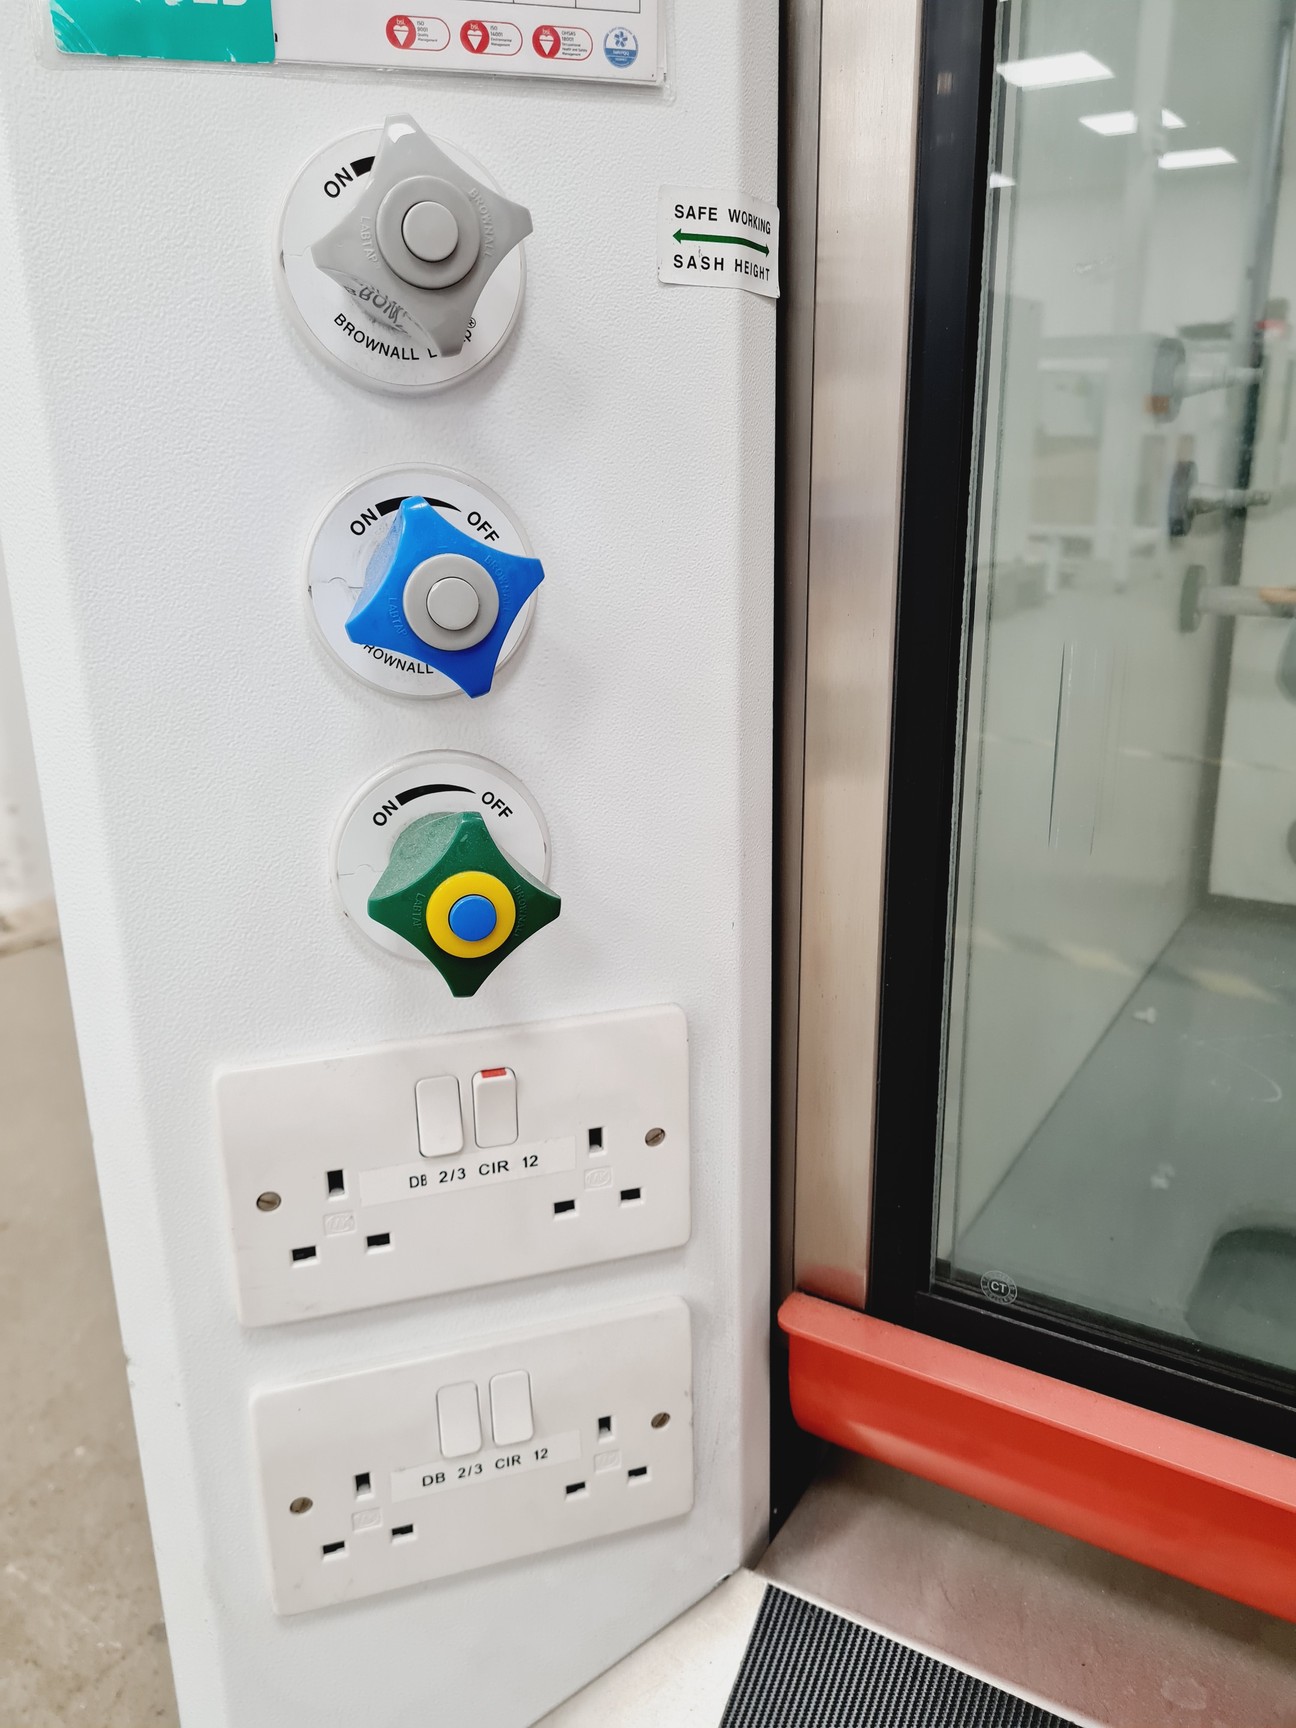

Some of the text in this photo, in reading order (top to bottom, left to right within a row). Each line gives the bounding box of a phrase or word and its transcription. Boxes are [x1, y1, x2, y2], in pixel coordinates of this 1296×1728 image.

[323, 167, 354, 199] ON
[467, 187, 495, 258] BROWNALL
[674, 204, 771, 235] SAFE WORKING
[673, 254, 771, 281] SASH HEIGHT
[333, 313, 420, 361] BROWNALL
[350, 508, 379, 536] ON
[466, 511, 500, 542] OFF
[362, 645, 435, 675] ROWNALL
[372, 800, 399, 827] ON
[481, 791, 514, 819] OFF
[409, 1154, 539, 1189] DB 2/3 CIR 12
[990, 1280, 1008, 1294] CT
[422, 1447, 549, 1487] DB 2/3 CIR 12
